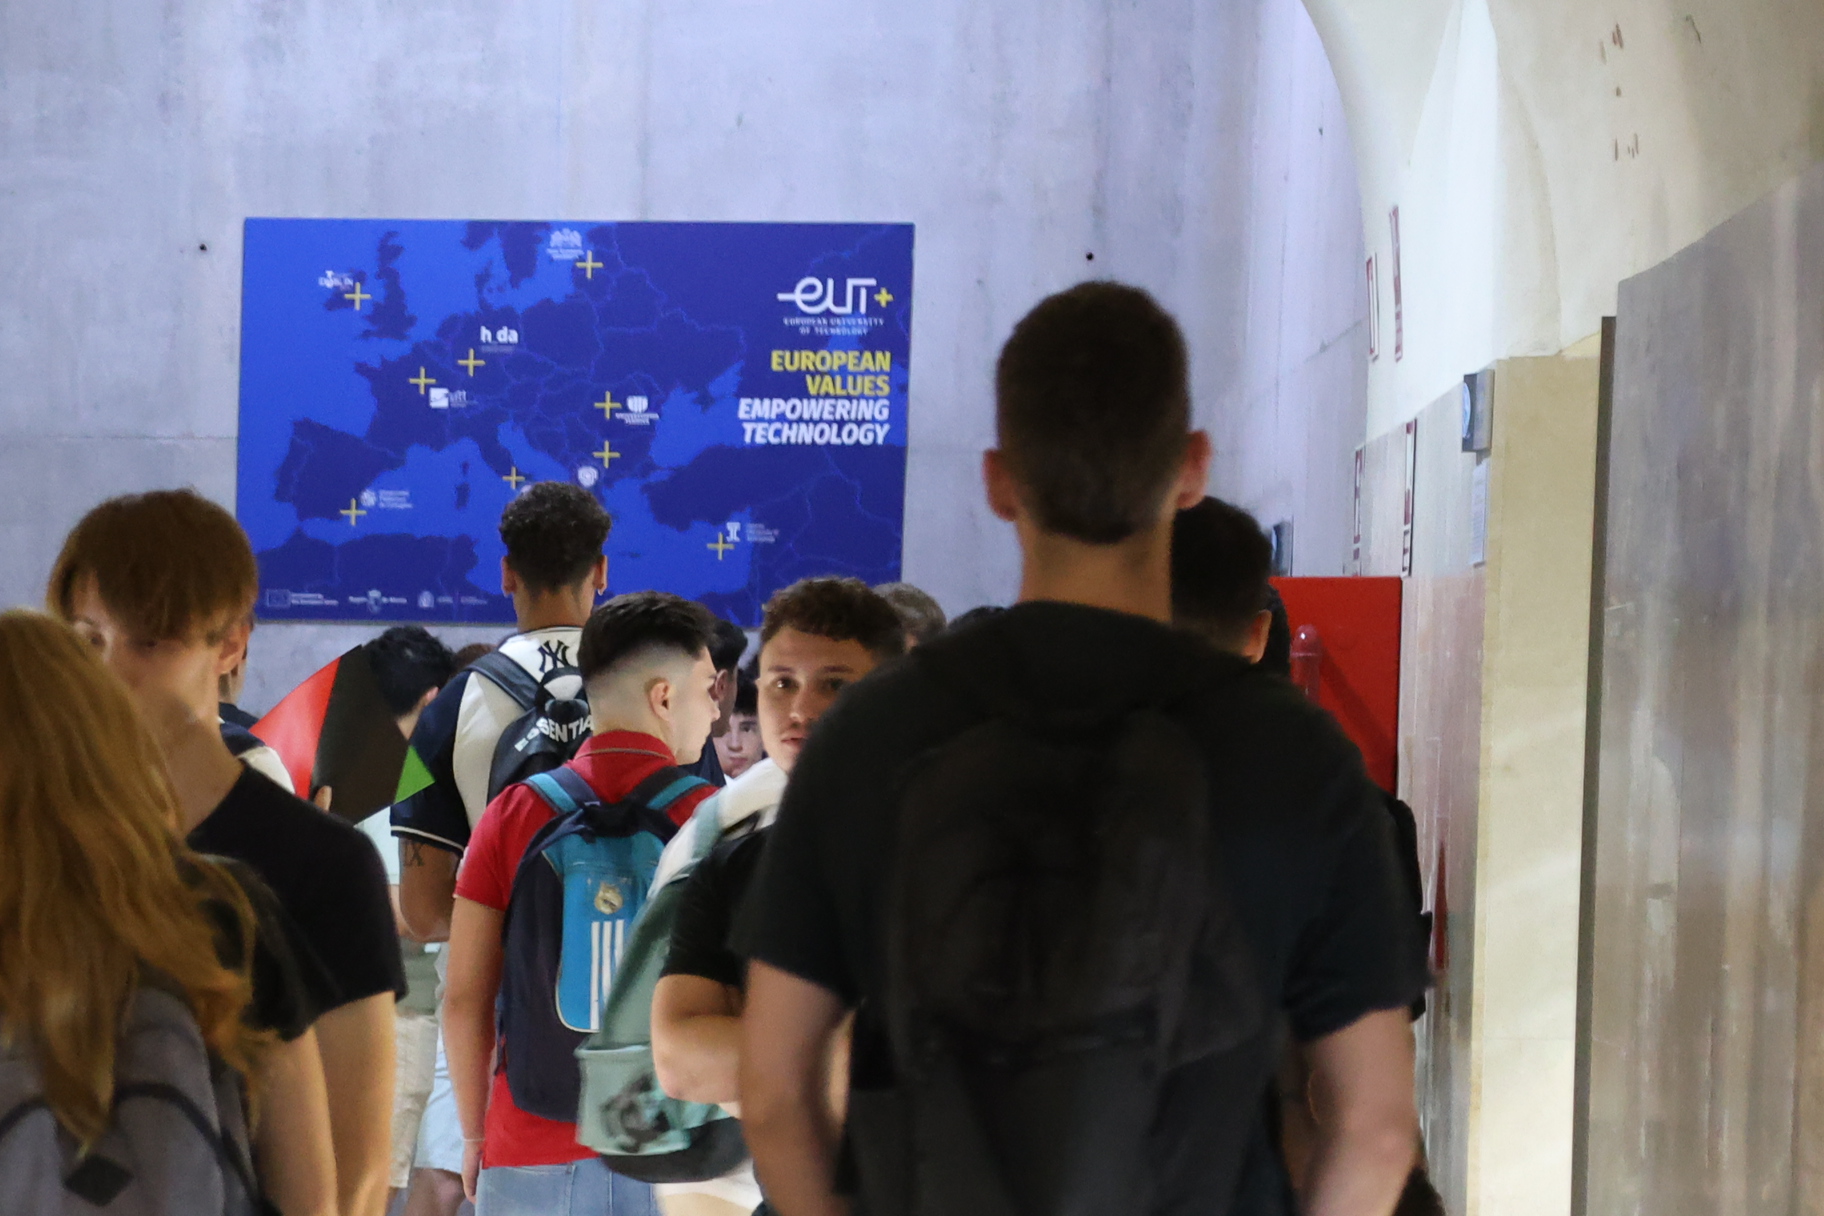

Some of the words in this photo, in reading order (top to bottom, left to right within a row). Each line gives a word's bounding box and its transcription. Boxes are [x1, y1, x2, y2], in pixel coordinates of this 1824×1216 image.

[771, 350, 891, 372] EUROPEAN
[806, 374, 890, 396] VALUES
[738, 398, 890, 421] EMPOWERING
[742, 422, 890, 445] TECHNOLOGY
